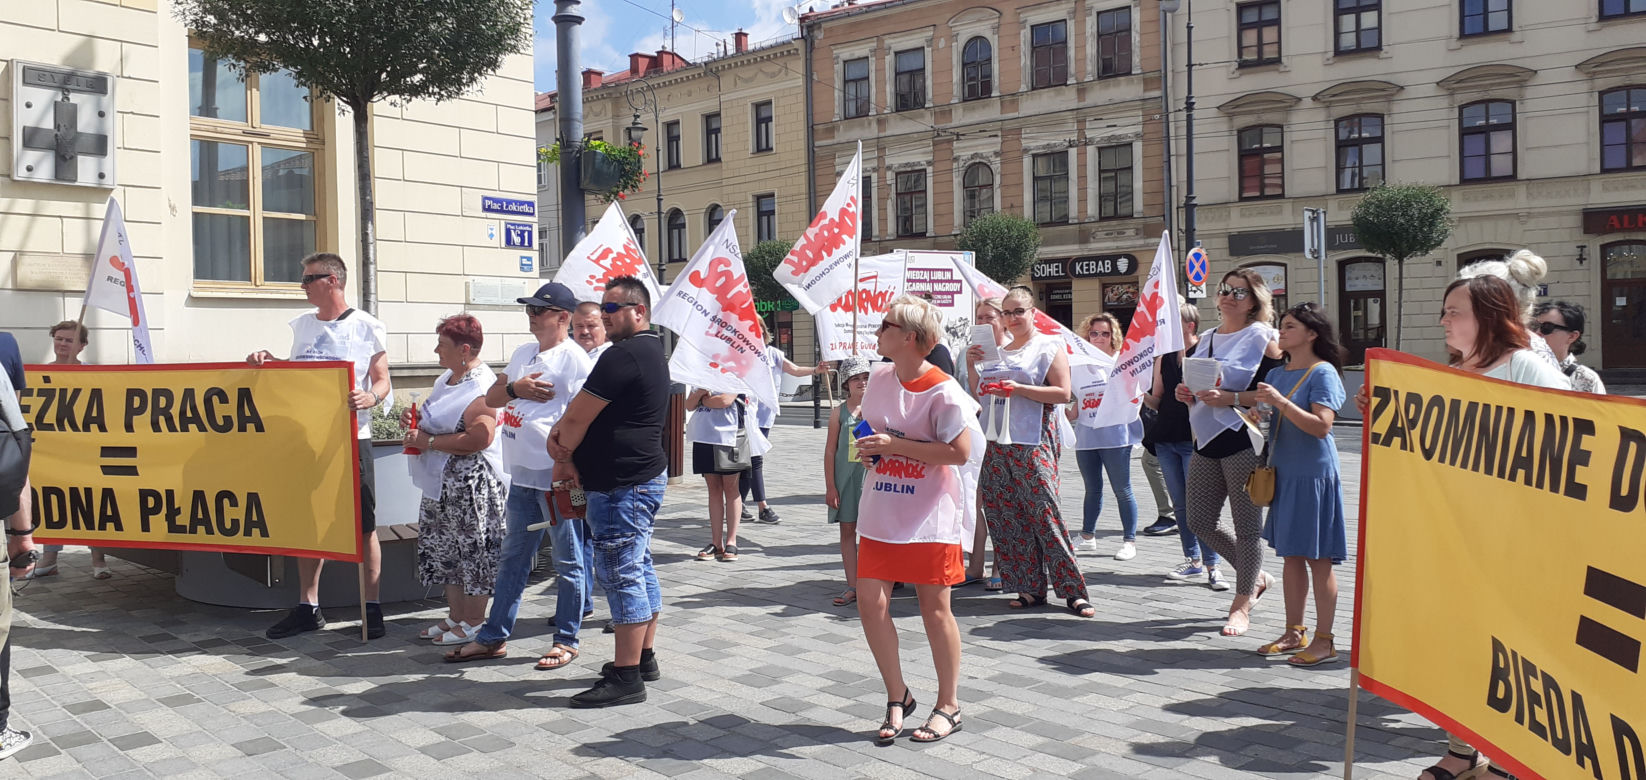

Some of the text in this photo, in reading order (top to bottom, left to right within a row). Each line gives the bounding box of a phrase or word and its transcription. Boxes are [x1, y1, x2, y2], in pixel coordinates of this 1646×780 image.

[485, 200, 534, 213] Plac Łokietka
[931, 271, 952, 280] LUBLIN
[1034, 260, 1111, 277] SOHEL KEBAB
[934, 283, 961, 292] NAGRODY
[676, 290, 710, 317] REGION
[715, 331, 746, 354] LUBLIN
[124, 387, 265, 433] PRACA
[1371, 386, 1646, 513] ZAPOMNIANE D
[873, 481, 915, 494] UBLIN
[138, 488, 270, 538] PŁACA
[1487, 635, 1603, 780] BIEDA
